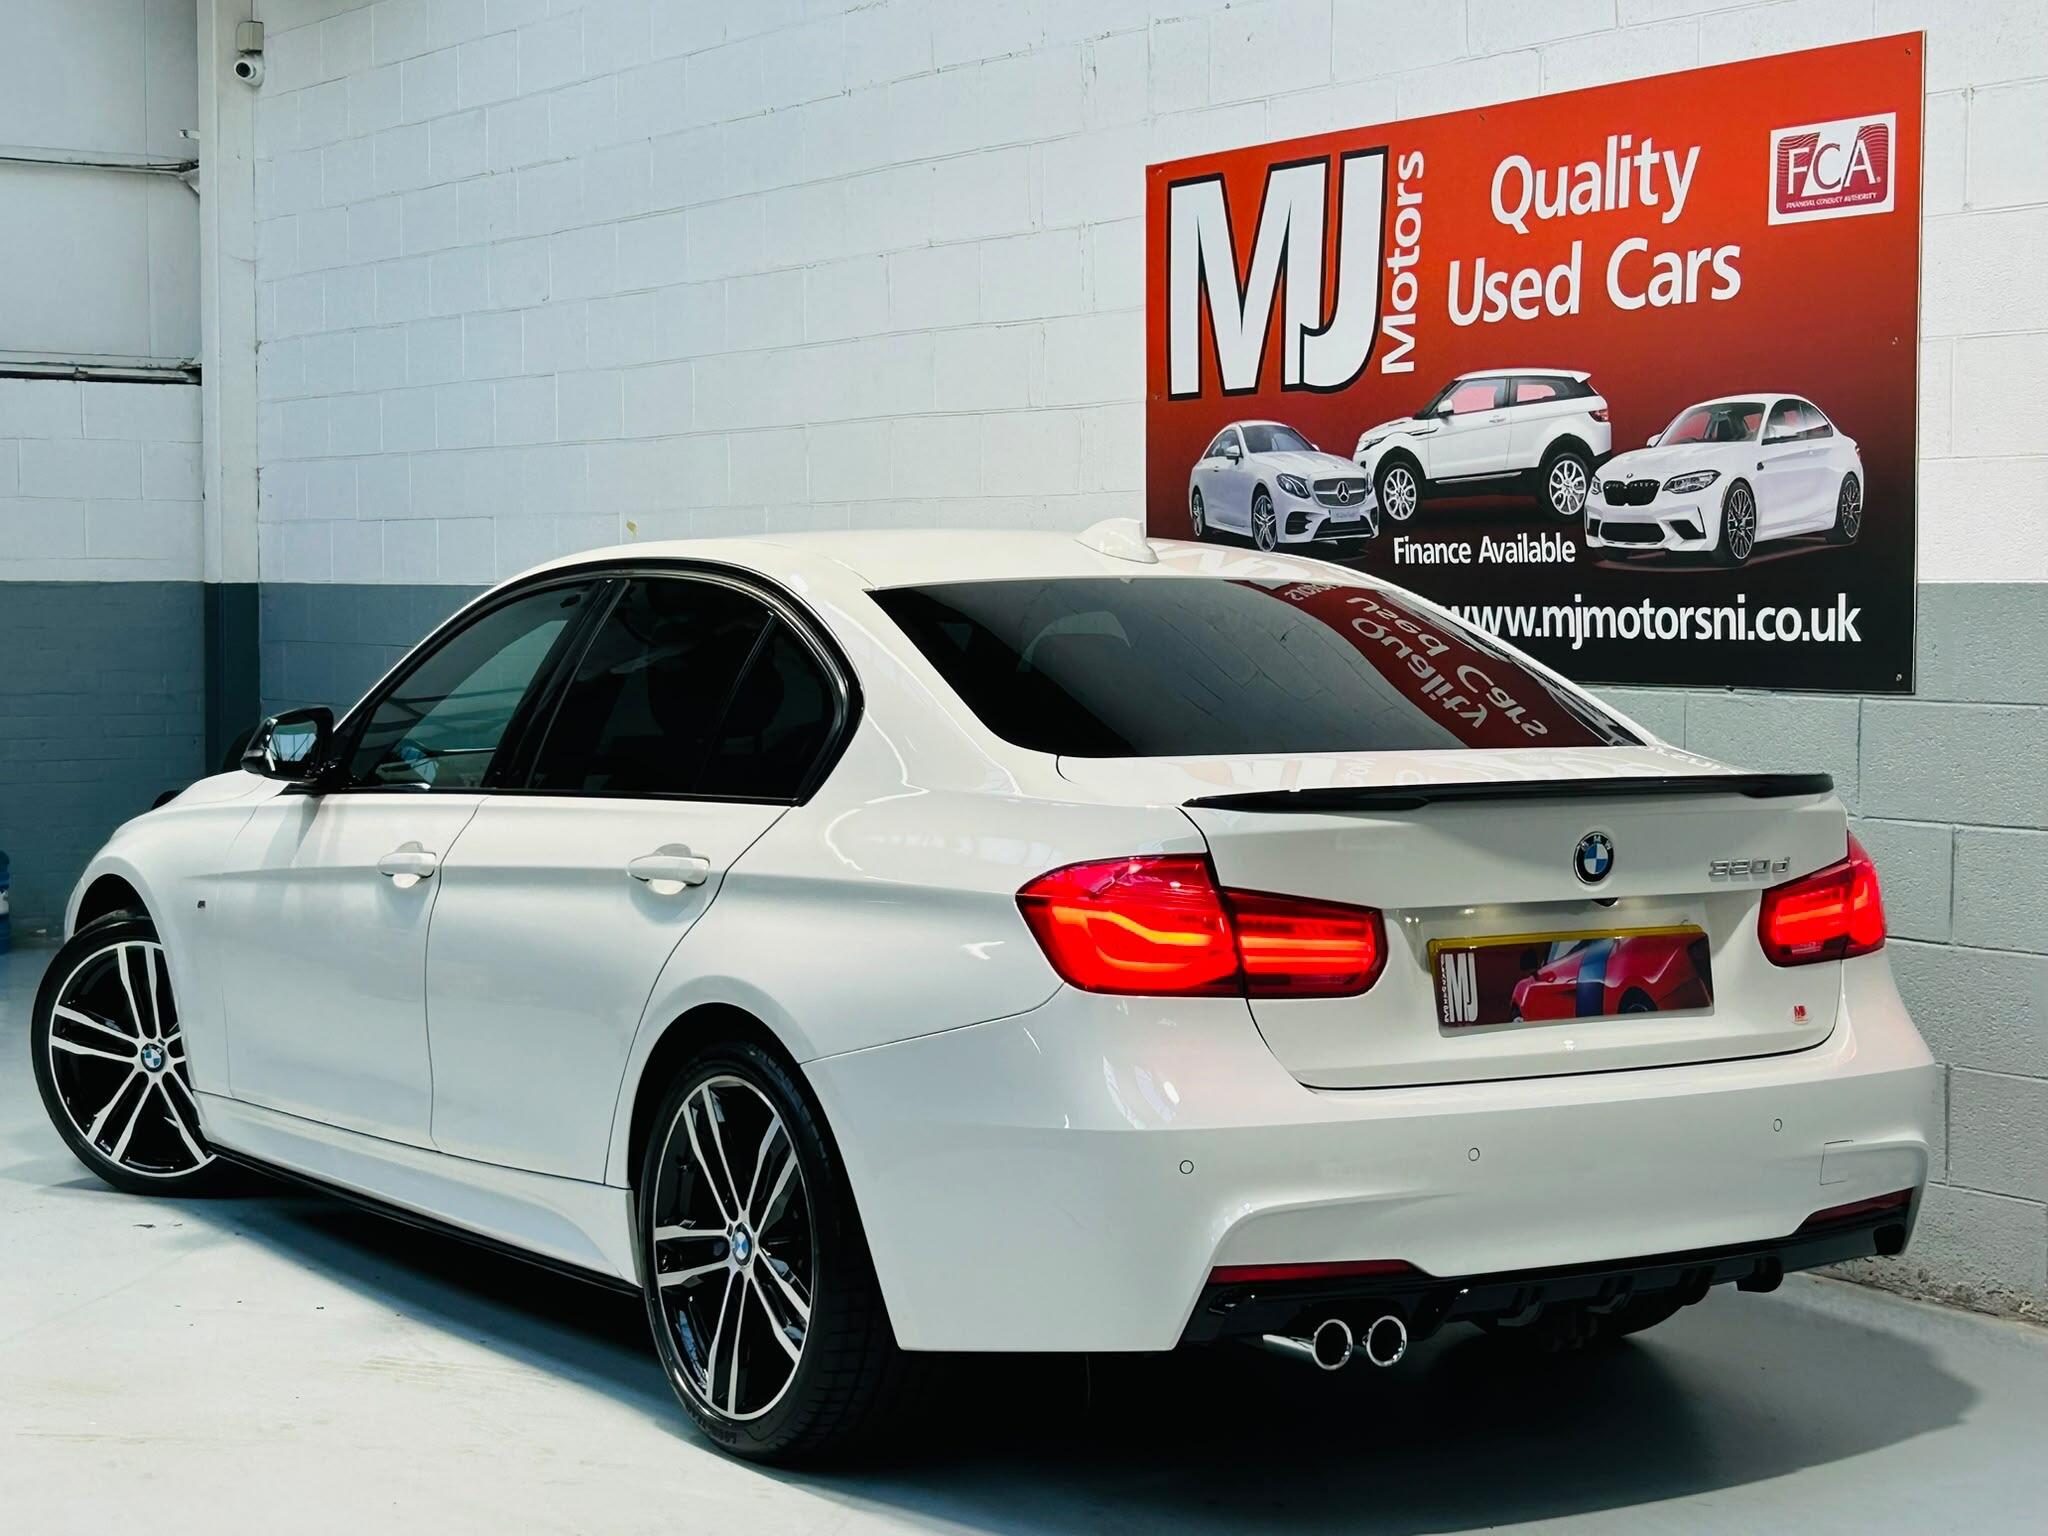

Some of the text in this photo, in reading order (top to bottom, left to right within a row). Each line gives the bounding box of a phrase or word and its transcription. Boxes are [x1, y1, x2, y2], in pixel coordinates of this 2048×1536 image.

[1491, 134, 1701, 234] Quality
[1787, 139, 1877, 195] FCA
[1168, 145, 1388, 401] MJ
[1381, 150, 1424, 374] Motors
[1448, 237, 1742, 327] Used Cars
[1393, 532, 1577, 565] Finance Available
[1708, 856, 1791, 878] 320d
[1444, 952, 1479, 1023] MJ
